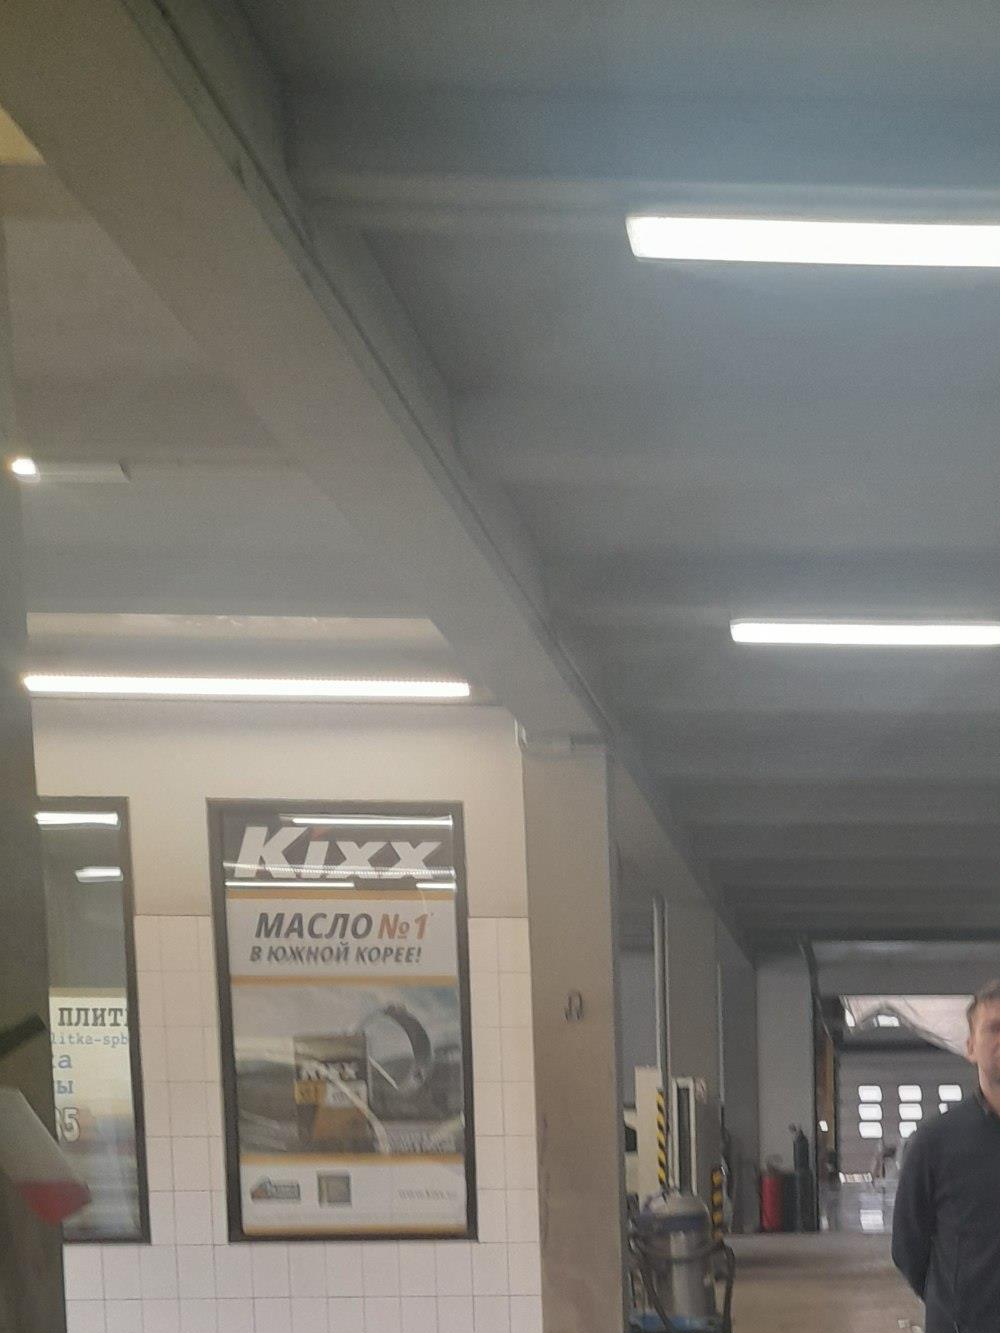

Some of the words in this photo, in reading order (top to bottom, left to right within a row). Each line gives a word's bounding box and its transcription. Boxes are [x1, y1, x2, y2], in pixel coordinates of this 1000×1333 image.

[234, 827, 442, 879] Kixx
[254, 912, 373, 939] МАСЛО
[250, 946, 262, 962] В
[267, 942, 350, 963] ЮЖНОЙ
[354, 946, 422, 963] КОРЕЕ!
[58, 1007, 128, 1027] ПЛИТ
